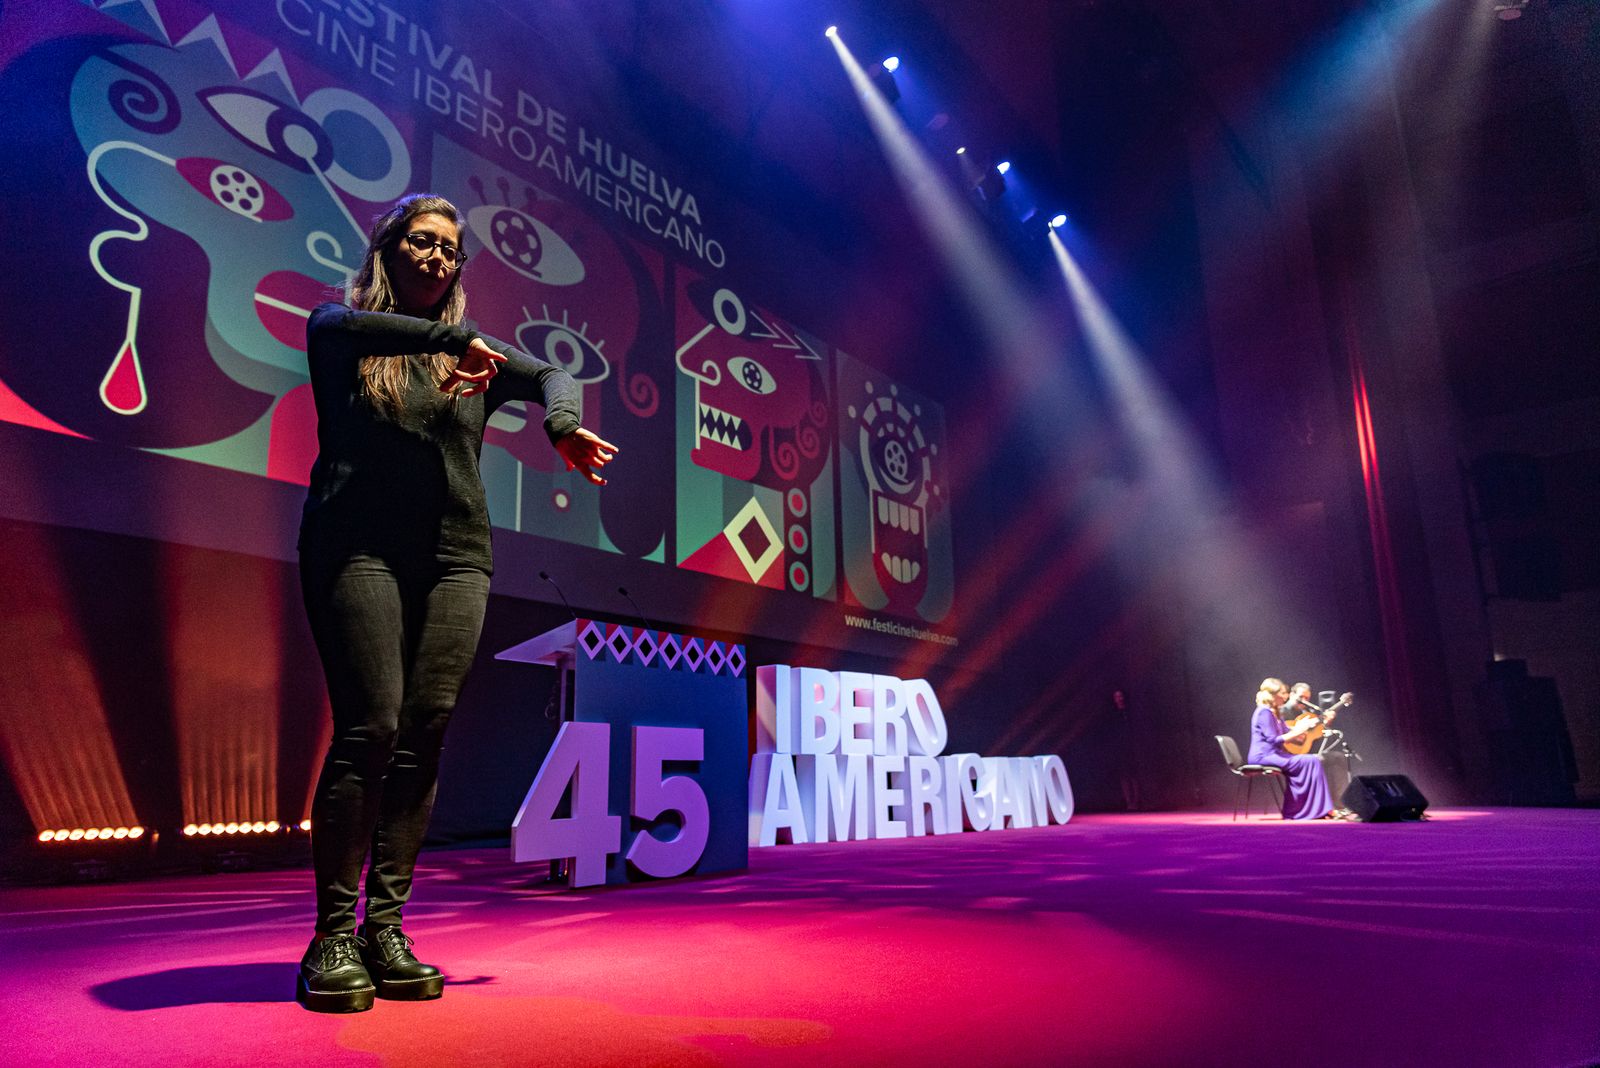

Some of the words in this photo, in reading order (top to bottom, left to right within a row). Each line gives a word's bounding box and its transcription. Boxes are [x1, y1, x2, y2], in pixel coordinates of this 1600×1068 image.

[276, 0, 397, 87] CINE
[413, 66, 726, 269] IBEROAMERICANO
[517, 90, 567, 145] DE
[578, 127, 703, 226] HUELVA
[844, 614, 959, 647] www.festicinehuelva.com
[755, 663, 949, 757] IBERO
[510, 720, 711, 889] 45
[749, 752, 1075, 848] AMERICANO
